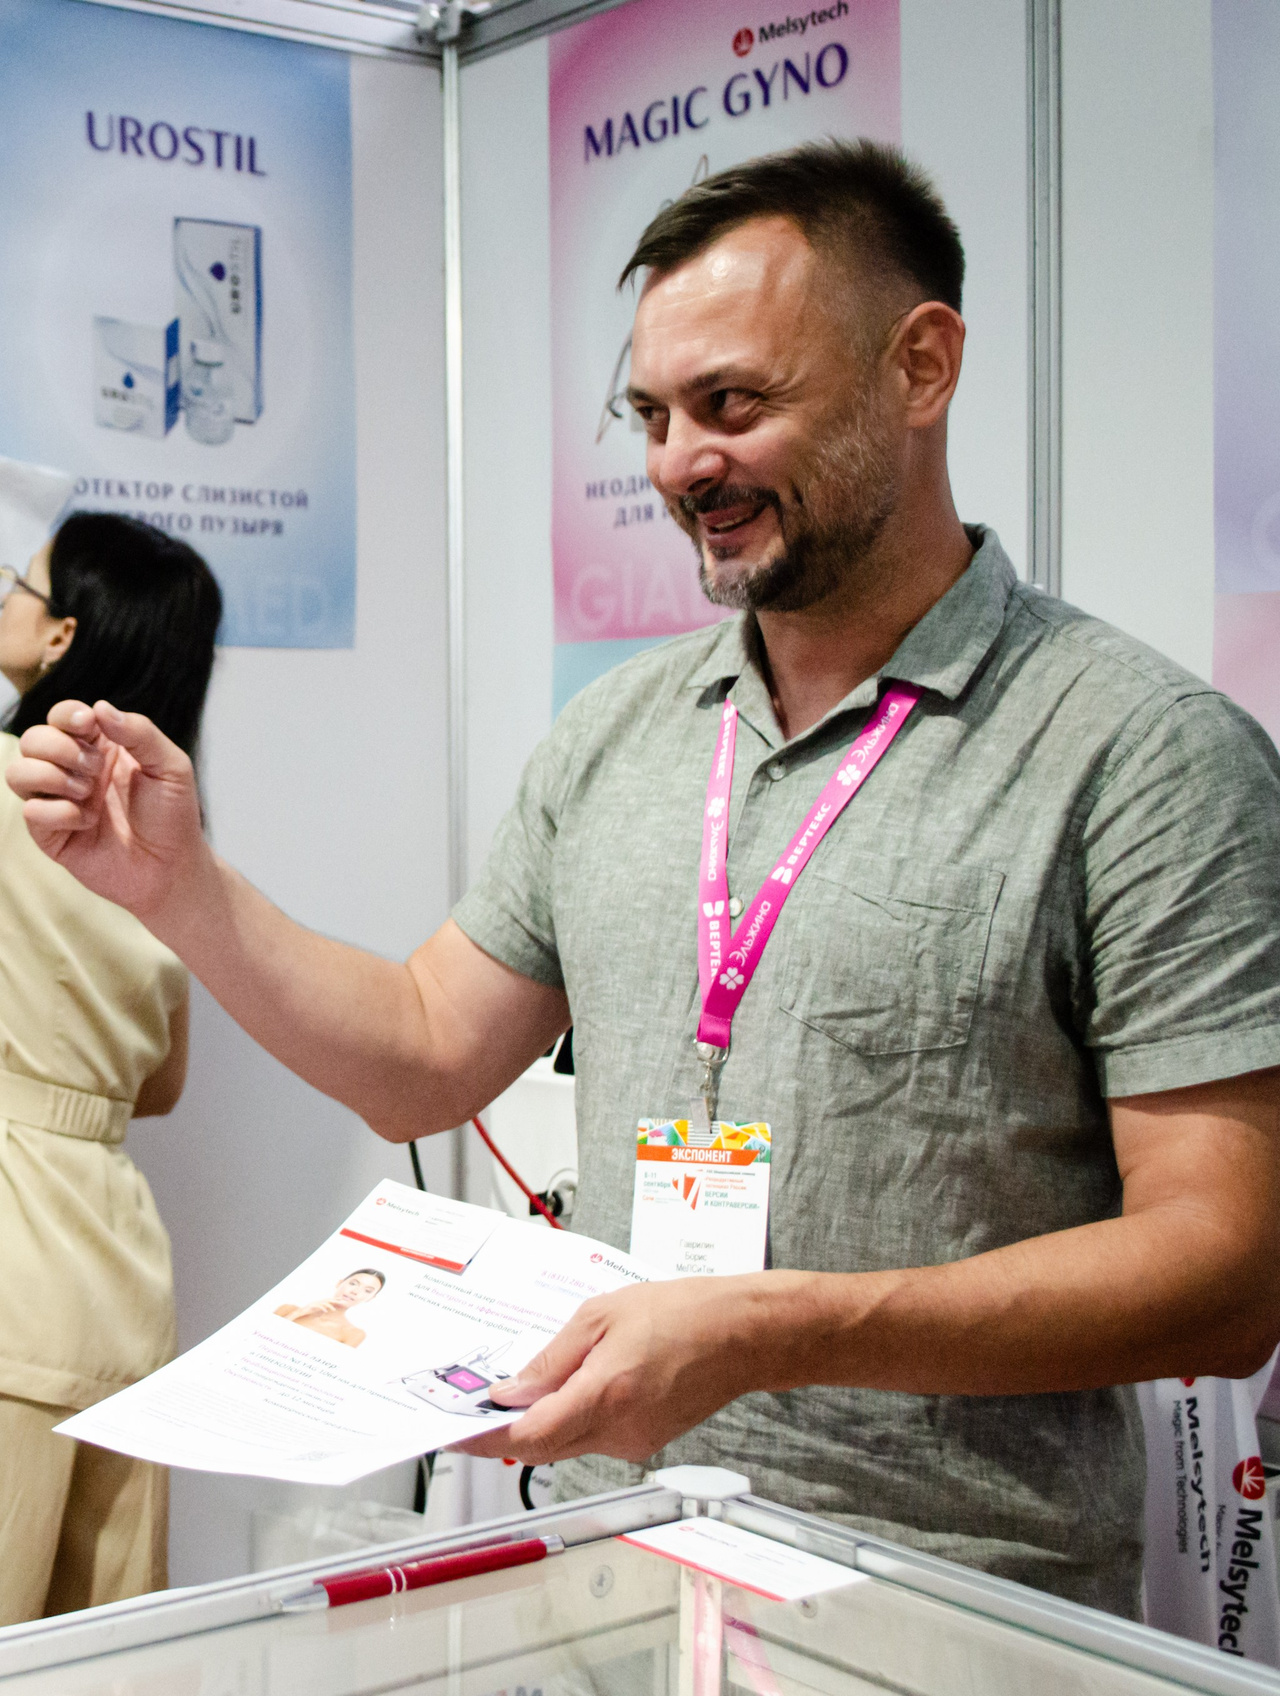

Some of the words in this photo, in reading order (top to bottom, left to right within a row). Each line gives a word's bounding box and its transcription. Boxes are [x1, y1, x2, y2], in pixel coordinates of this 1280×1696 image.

[758, 0, 849, 43] Melsytech
[583, 85, 709, 164] MAGIC
[723, 42, 849, 117] GYNO
[84, 110, 267, 177] UROSTIL
[74, 477, 173, 501] ОТЕКТОР
[181, 484, 309, 509] СЛИЗИСТОЙ
[585, 475, 652, 499] НЕОДИ
[200, 515, 284, 535] ПУЗЫРЯ
[615, 503, 654, 528] ДЛЯ
[786, 801, 832, 868] ВЕРТЕКС
[728, 899, 772, 967] Эльжина
[671, 1147, 733, 1163] ЭКСПОНЕНТ
[704, 1190, 729, 1199] ВЕРСИИ
[684, 1251, 707, 1262] Борис
[408, 1290, 440, 1308] женских
[442, 1304, 483, 1324] интимных
[414, 1282, 431, 1293] для
[474, 1304, 531, 1327] эффективного
[422, 1273, 472, 1296] Компактный
[473, 1292, 496, 1304] лазер
[543, 1314, 567, 1326] поко
[1173, 1400, 1184, 1437] Magic
[1174, 1439, 1185, 1467] from
[1185, 1396, 1210, 1574] Melsytech
[1176, 1468, 1188, 1554] Technologies
